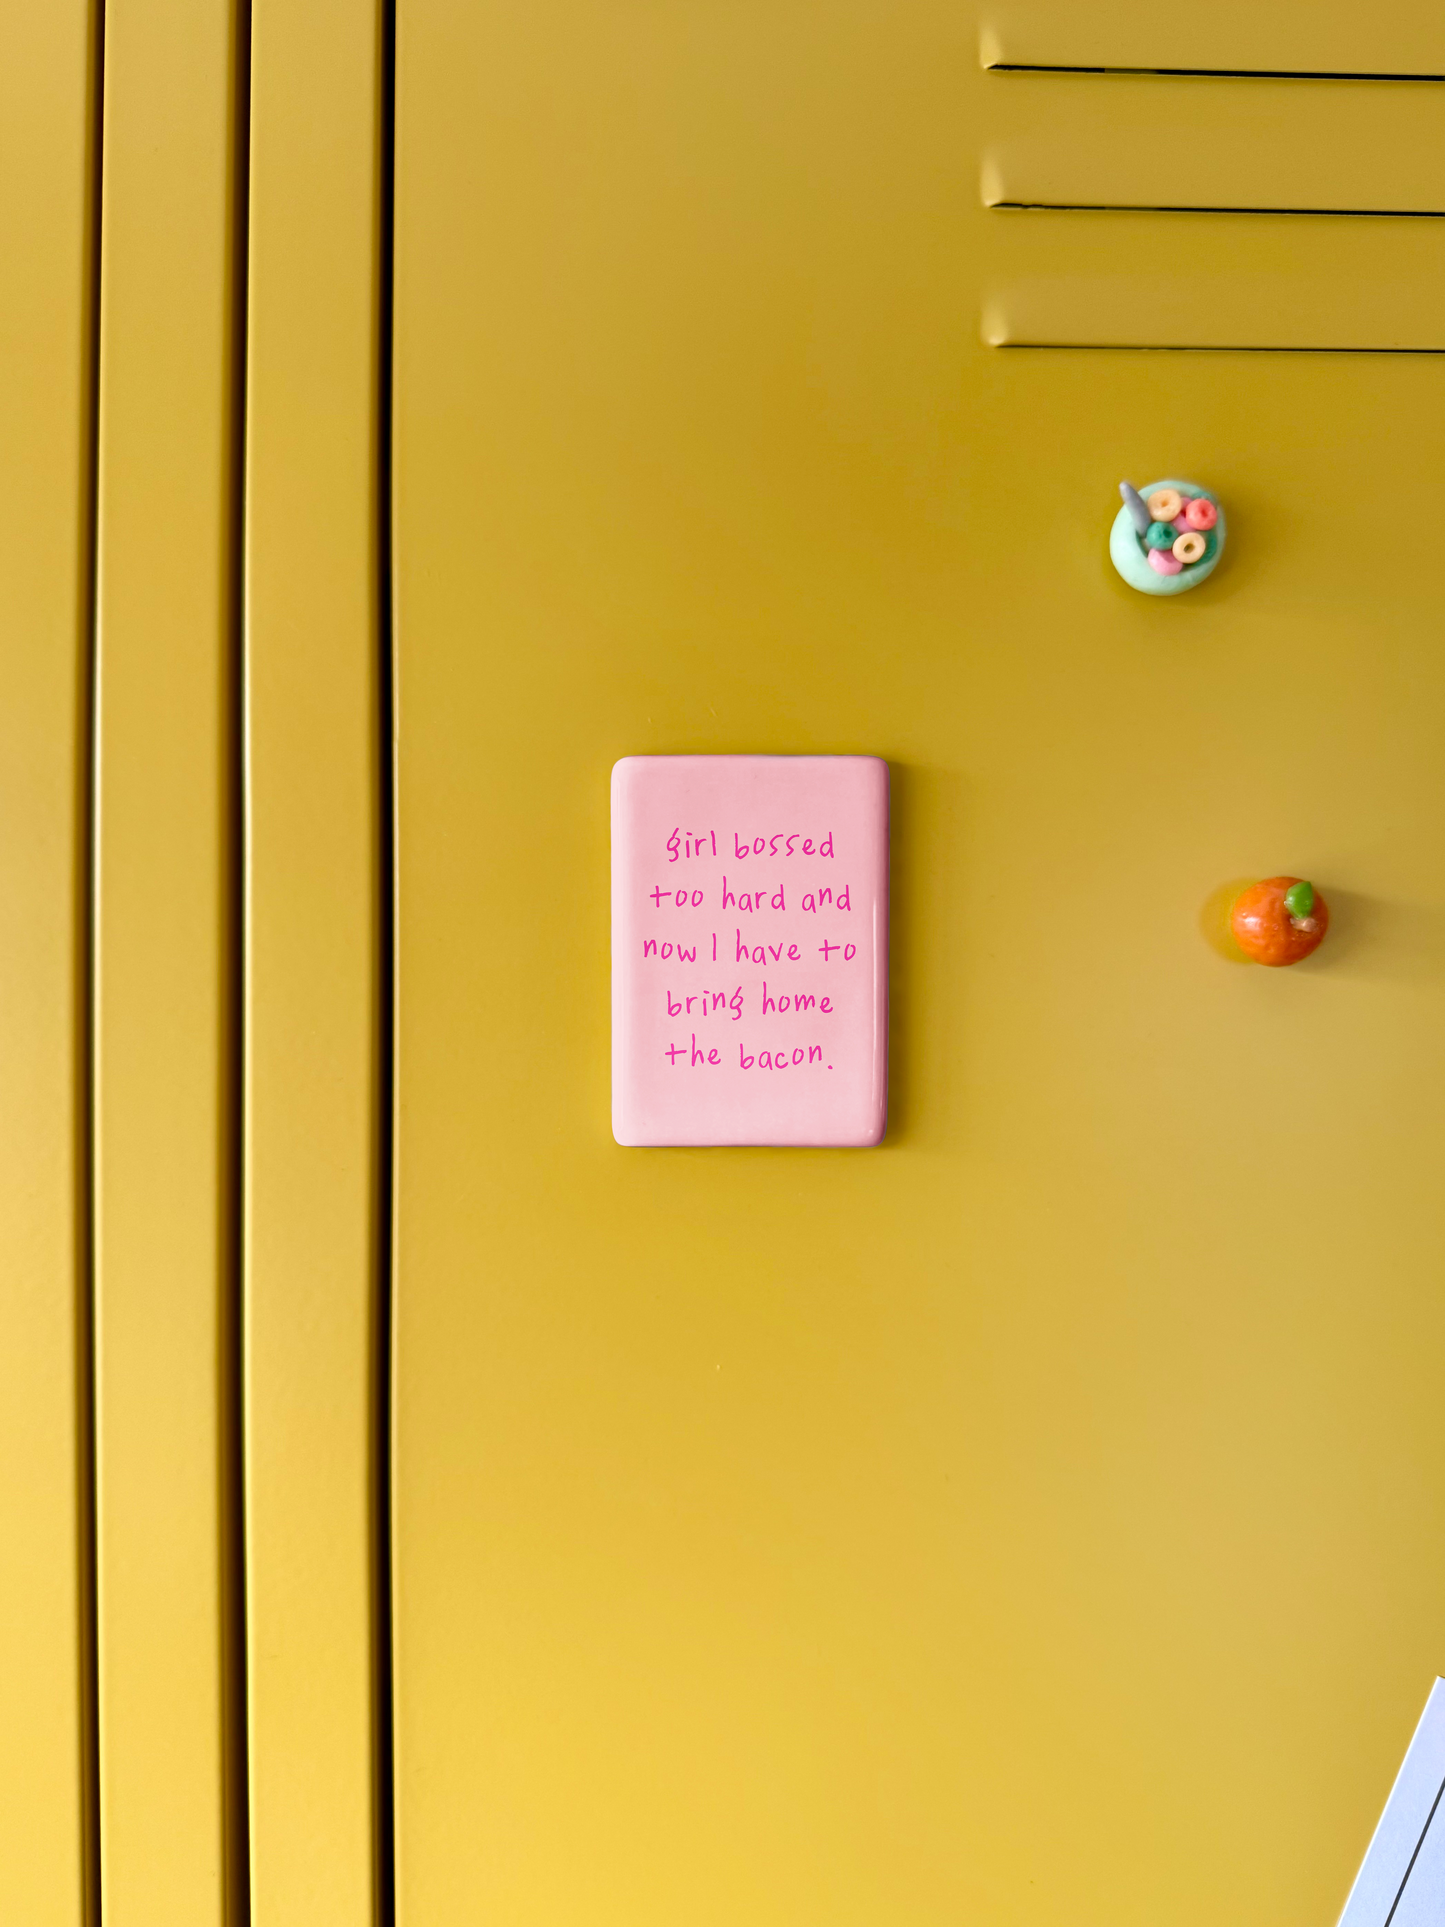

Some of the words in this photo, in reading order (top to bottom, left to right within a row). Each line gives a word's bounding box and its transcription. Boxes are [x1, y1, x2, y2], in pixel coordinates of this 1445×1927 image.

[666, 827, 717, 863] girl
[734, 830, 835, 860] bossed
[649, 885, 704, 909] too
[722, 875, 786, 914] hard
[801, 884, 852, 914] and
[643, 939, 697, 963] now
[712, 932, 717, 962] I
[735, 928, 802, 966] have
[818, 938, 857, 962] to
[666, 985, 744, 1021] bring
[762, 980, 834, 1016] home
[664, 1033, 722, 1068] the
[739, 1043, 834, 1071] bacon.
